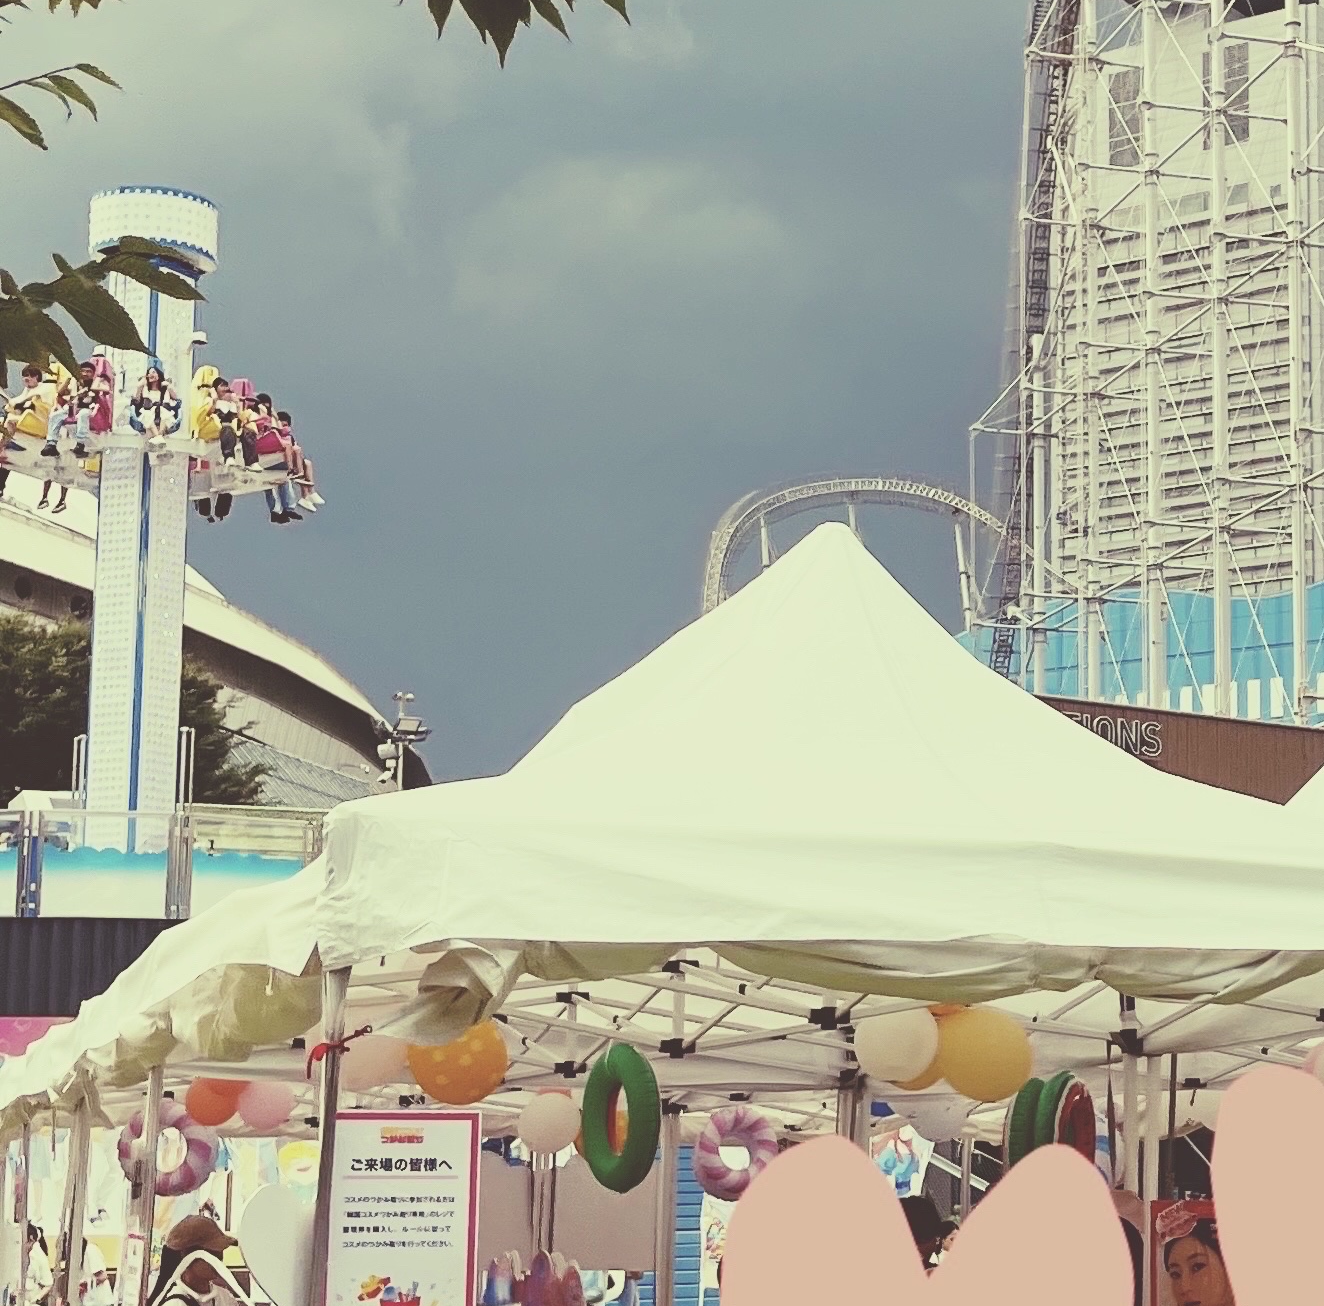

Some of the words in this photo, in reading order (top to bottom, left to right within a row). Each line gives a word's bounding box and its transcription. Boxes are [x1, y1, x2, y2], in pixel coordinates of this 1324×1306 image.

[1061, 711, 1163, 757] ONS
[350, 1157, 453, 1172] ご来場の皆様へ
